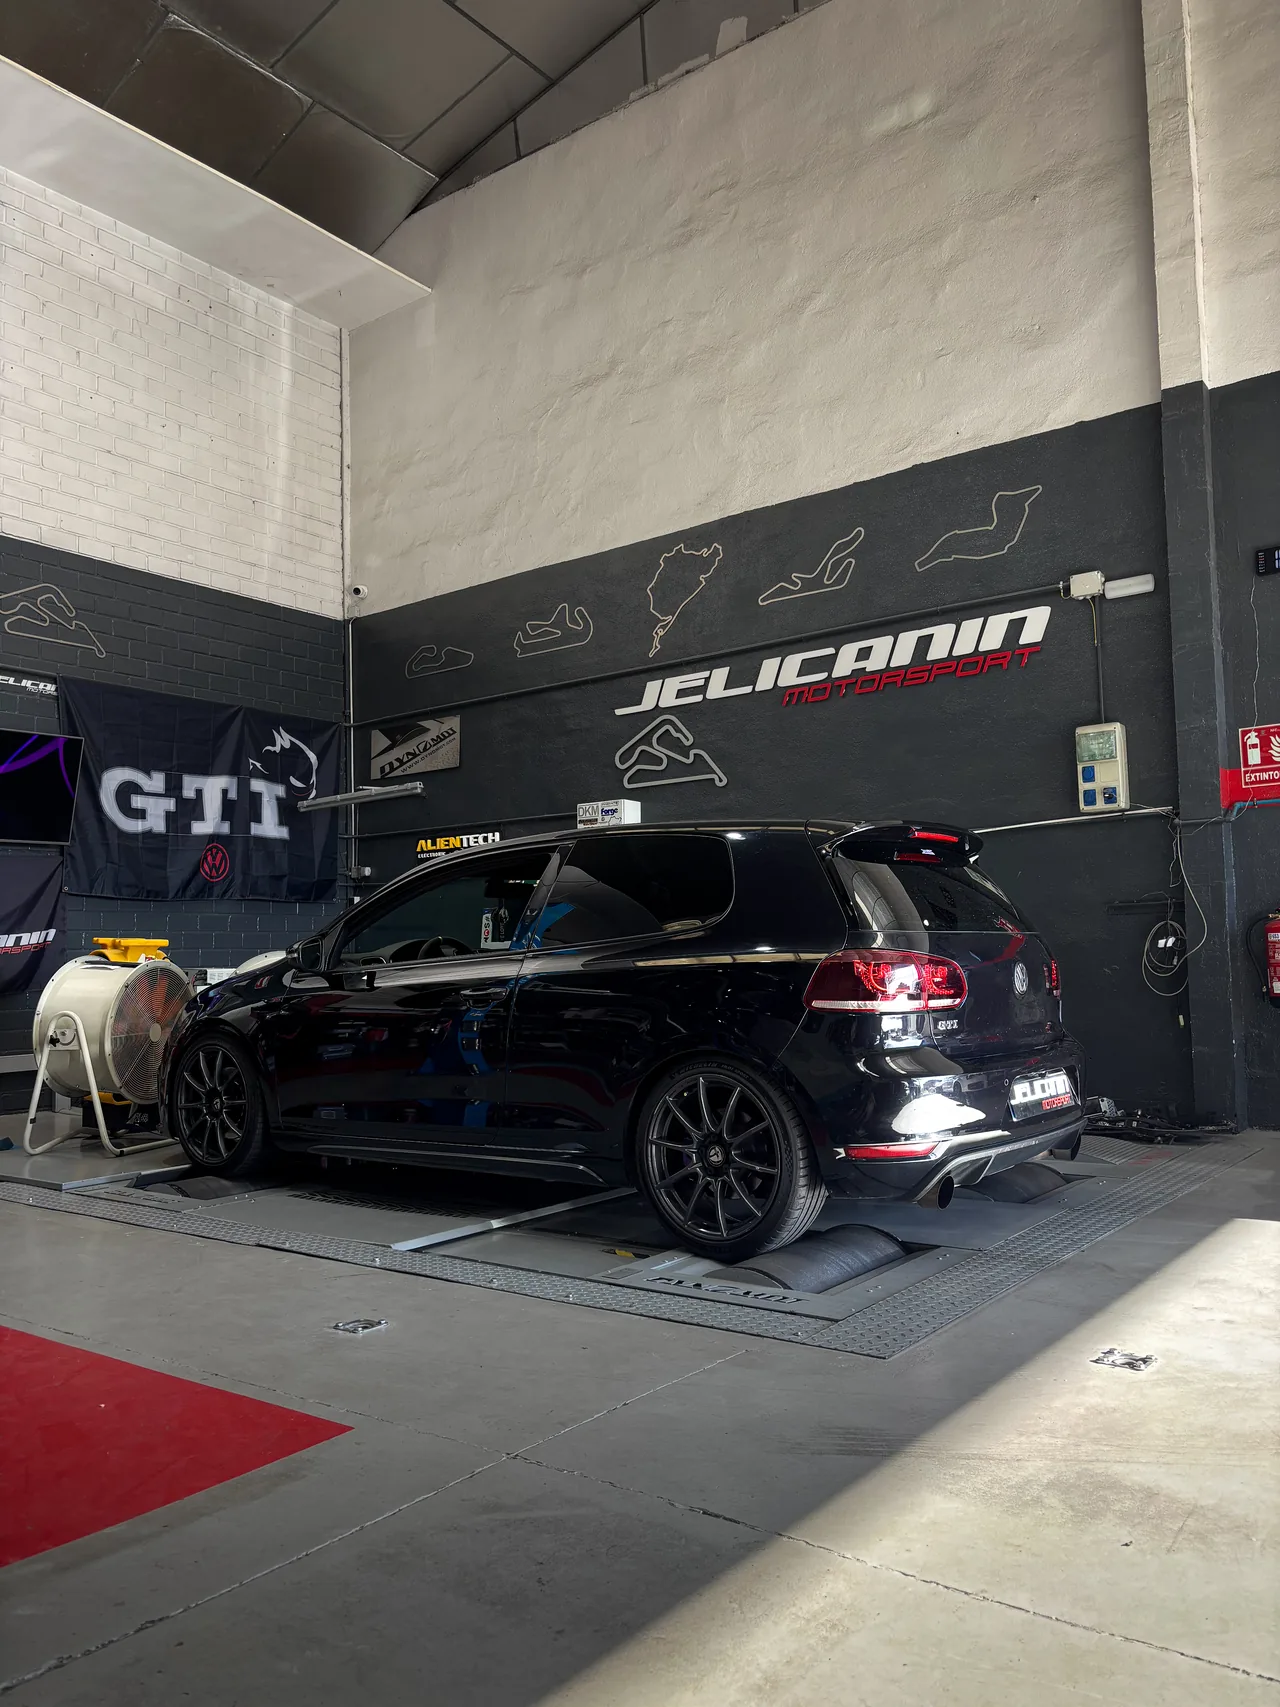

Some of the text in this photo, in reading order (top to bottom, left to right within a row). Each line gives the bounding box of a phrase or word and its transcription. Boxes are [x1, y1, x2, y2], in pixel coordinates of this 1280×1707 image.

[614, 606, 1051, 716] JELICANIN
[782, 646, 1041, 707] MOTORSPORT
[100, 766, 290, 840] GTI
[578, 805, 600, 817] DKM
[416, 832, 500, 852] ALIENTECH
[937, 1019, 959, 1030] GTI
